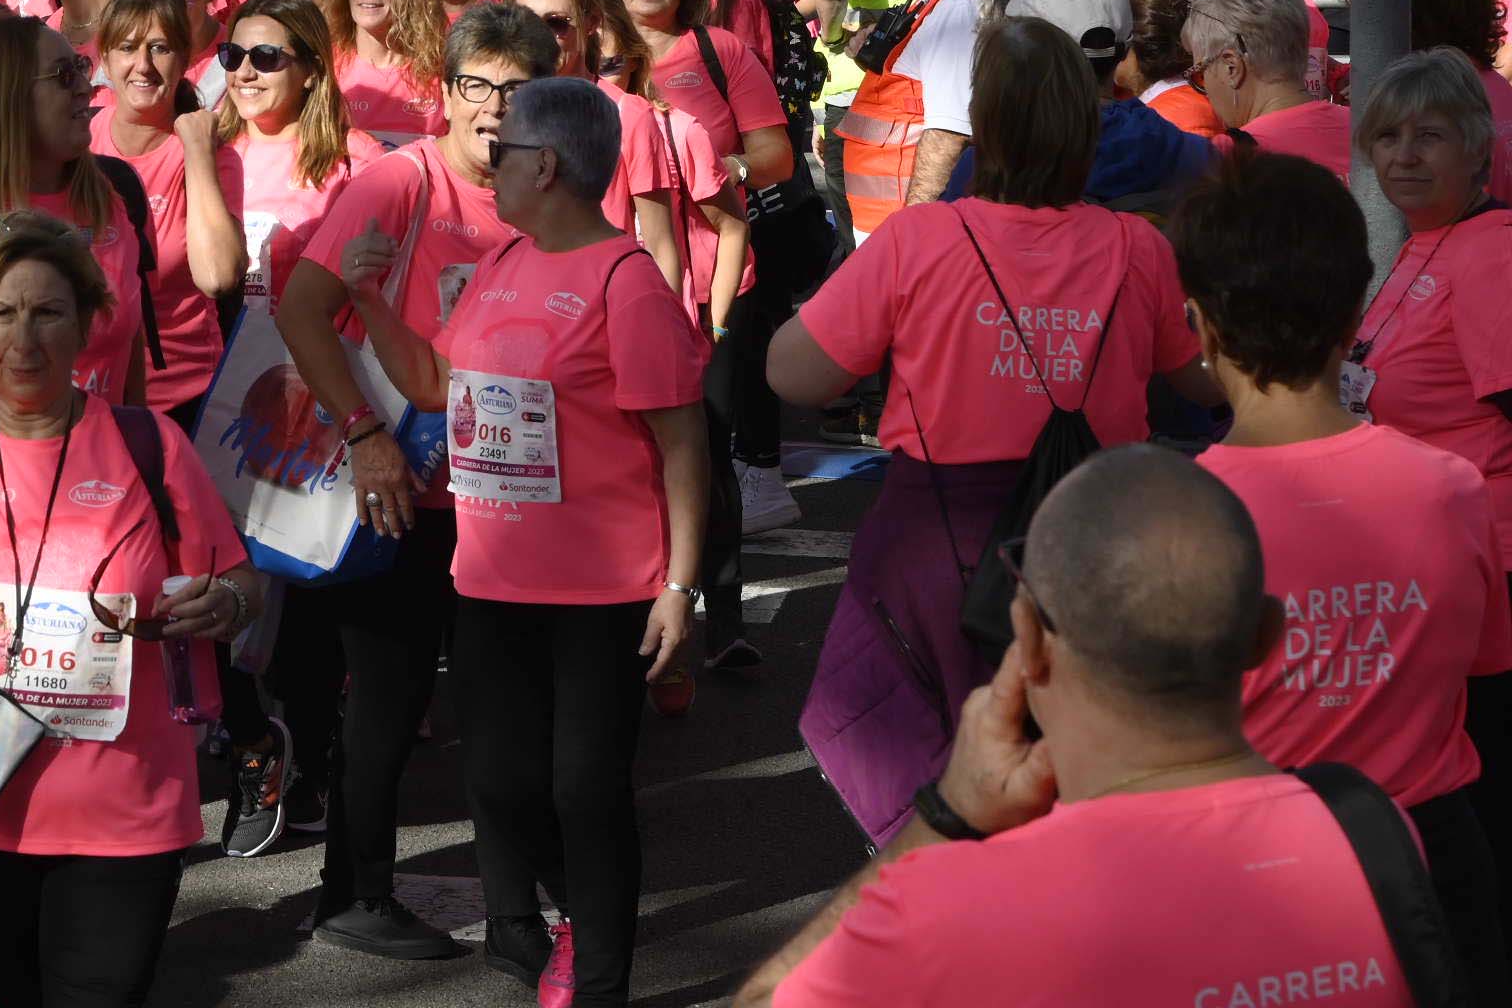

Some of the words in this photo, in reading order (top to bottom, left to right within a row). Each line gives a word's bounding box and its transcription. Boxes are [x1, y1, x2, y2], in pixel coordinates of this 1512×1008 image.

[976, 301, 1104, 332] CARRERA
[1000, 329, 1035, 355] DE
[1047, 333, 1080, 356] LA
[990, 353, 1084, 382] MUJER
[478, 423, 512, 443] 016
[479, 446, 507, 460] 23491
[509, 482, 550, 493] Santander
[1286, 623, 1332, 660] DE
[1346, 617, 1391, 651] LA
[21, 647, 77, 671] 016
[25, 675, 68, 690] 11680
[26, 694, 40, 703] DE
[41, 695, 55, 704] LA
[55, 696, 89, 706] MUJER
[63, 715, 115, 729] Santander
[1194, 957, 1387, 1008] CARRERA
